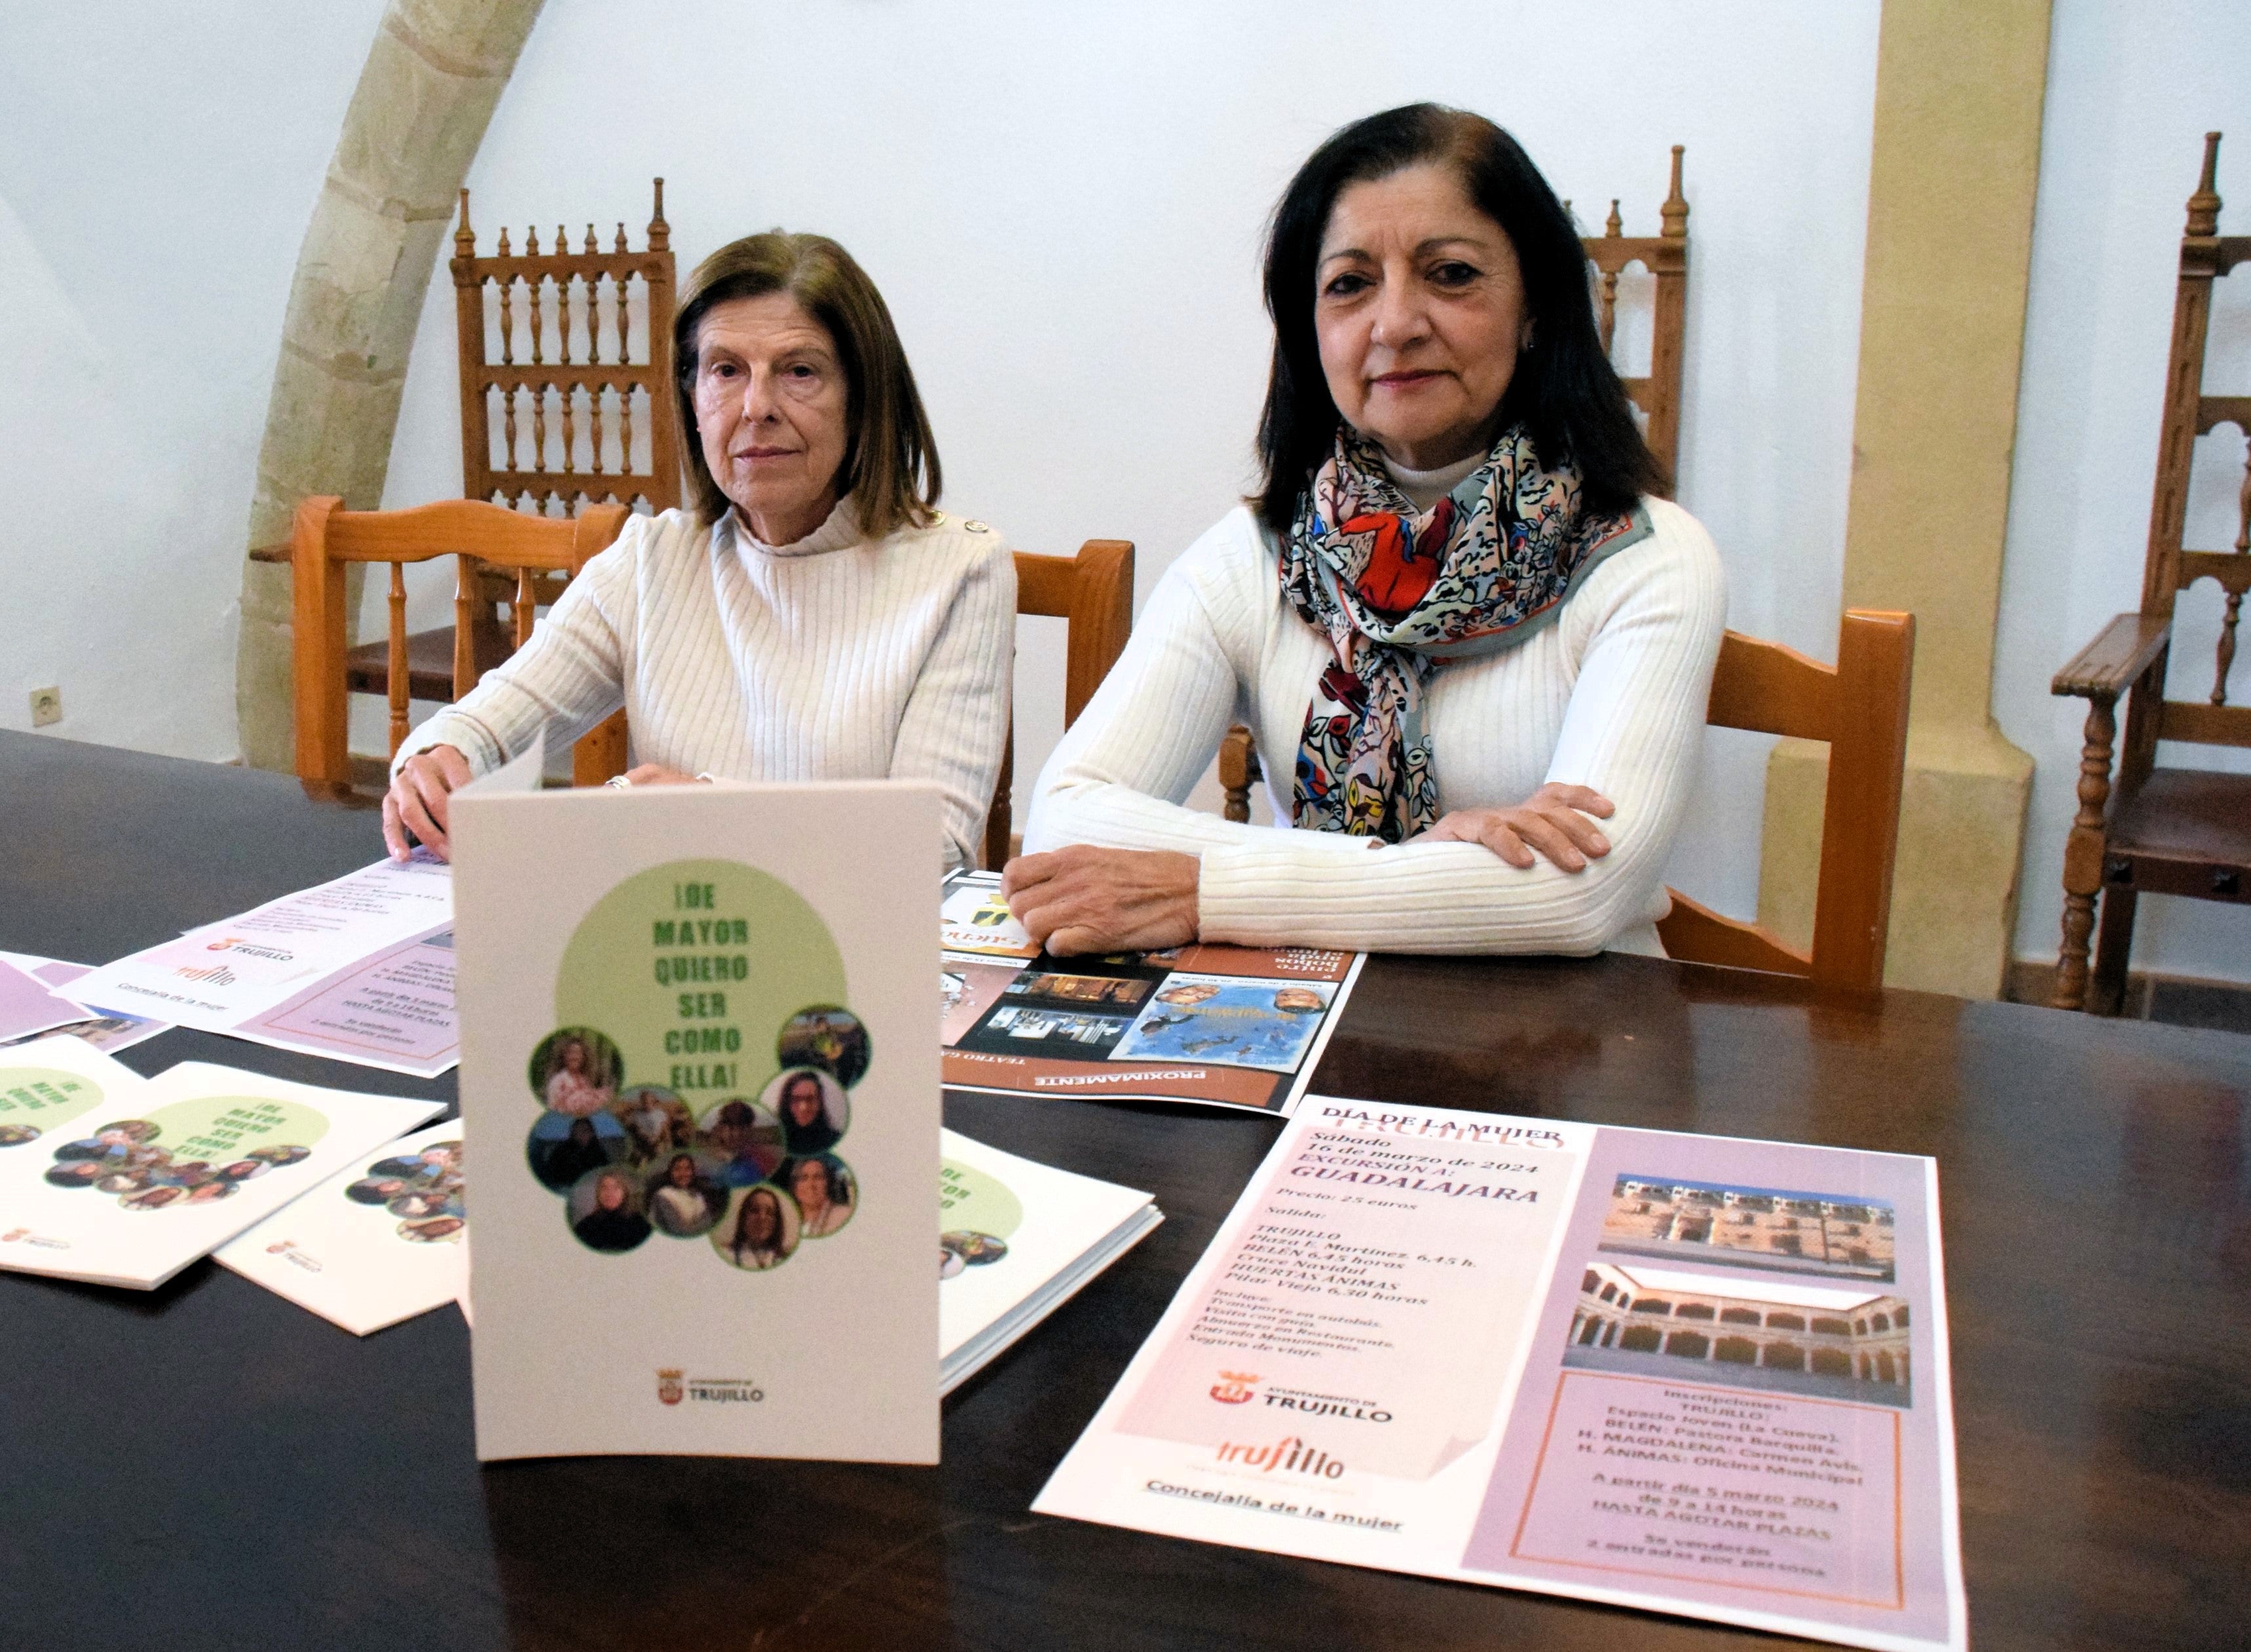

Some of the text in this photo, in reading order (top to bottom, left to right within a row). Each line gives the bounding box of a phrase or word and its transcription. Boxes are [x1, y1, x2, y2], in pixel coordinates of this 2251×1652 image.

[653, 919, 749, 947] MAYOR
[233, 947, 293, 961] TRUJILLO
[654, 955, 749, 987] QUIERO
[678, 993, 727, 1019] SER
[665, 1027, 741, 1054] COMO
[964, 1055, 1026, 1065] TEATRO
[671, 1064, 737, 1090] ELLA!
[1034, 1071, 1206, 1086] PROXIMAMENTE
[1322, 1107, 1561, 1141] DÍA DE LA MUJER
[1310, 1131, 1392, 1148] Sábado
[1298, 1152, 1456, 1177] EXCURSIÓN A:
[1307, 1143, 1540, 1174] 16 de marzo de 2024
[1291, 1166, 1540, 1203] GUADALAJARA
[1276, 1188, 1419, 1211] Precio: 25 euros
[1266, 1206, 1326, 1219] Salida:
[1256, 1225, 1341, 1241] TRUJILLO
[1351, 1255, 1407, 1270] horas
[1373, 1291, 1429, 1305] horas
[690, 1389, 764, 1403] TRUJILLO
[1264, 1394, 1392, 1422] TRUJILLO
[1593, 1500, 1658, 1517] HASTA
[1639, 1494, 1662, 1505] de
[1669, 1497, 1680, 1507] 9
[1730, 1505, 1787, 1519] horas
[1707, 1487, 1717, 1497] 5
[1792, 1496, 1838, 1510] 2024
[1270, 1502, 1299, 1513] de
[1305, 1506, 1326, 1519] la
[1332, 1513, 1404, 1530] mujer
